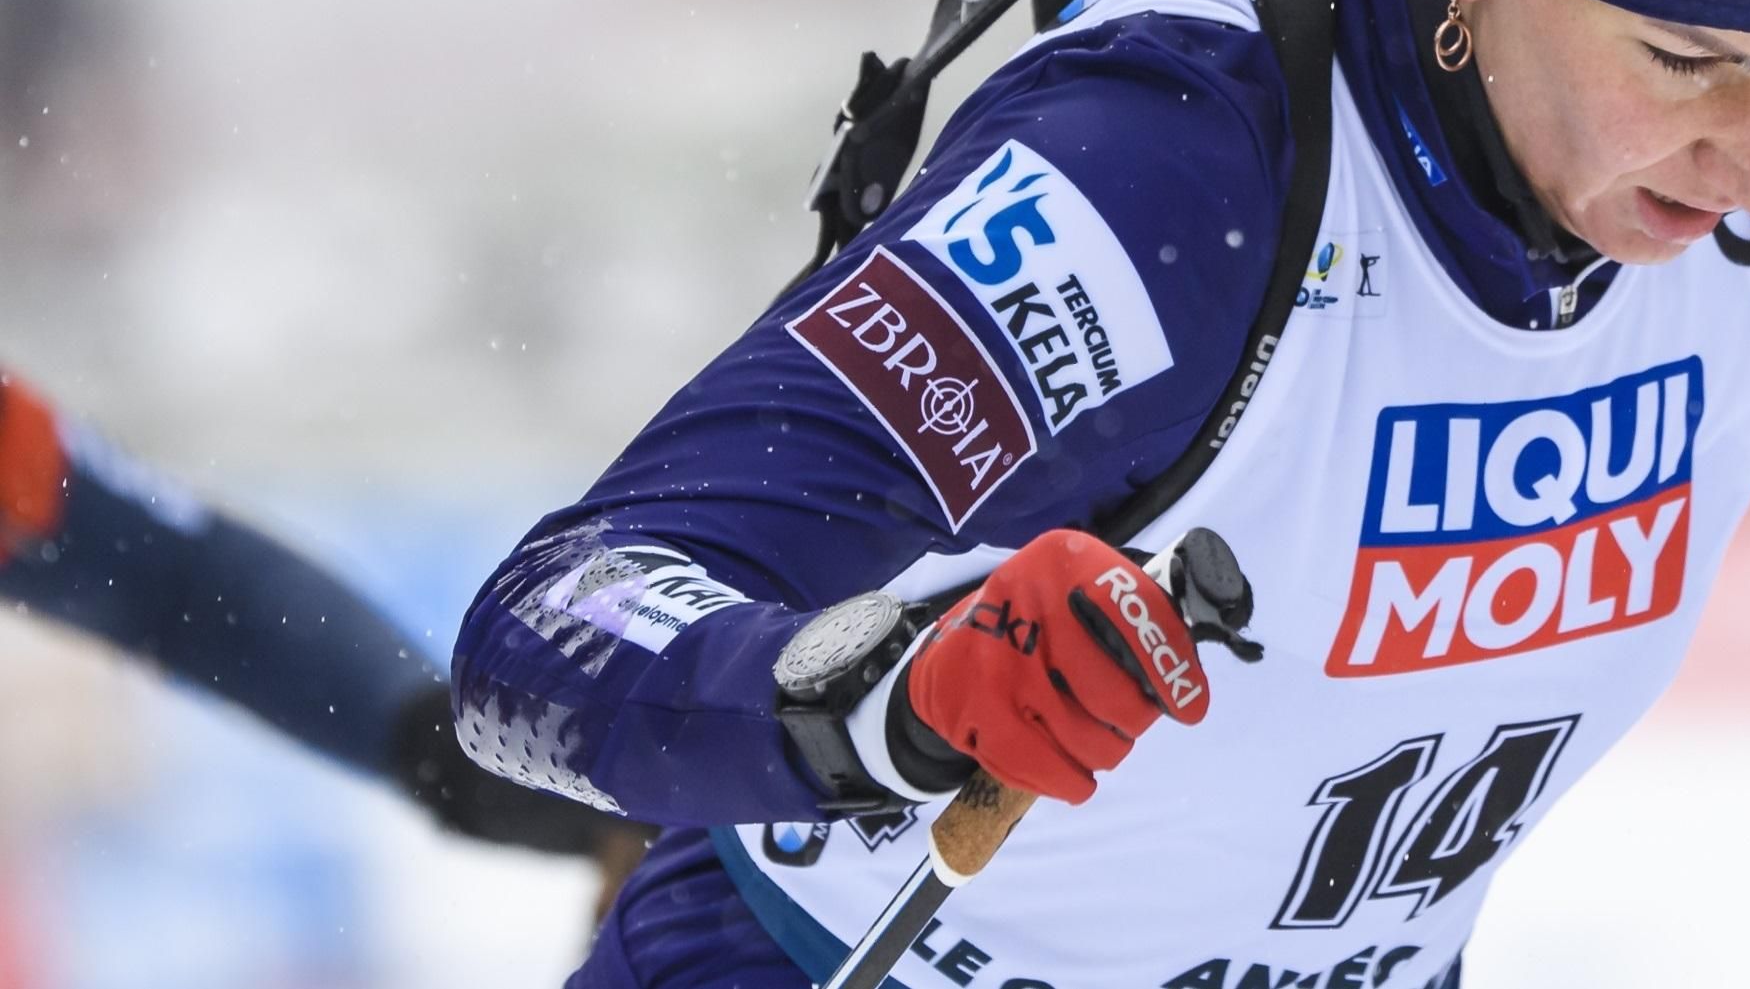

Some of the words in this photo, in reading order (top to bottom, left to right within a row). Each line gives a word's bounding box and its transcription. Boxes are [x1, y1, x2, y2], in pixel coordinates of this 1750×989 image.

[1056, 274, 1122, 397] TERCIUM
[1380, 372, 1688, 534] LIQUI
[1346, 497, 1686, 665] MOLY
[1270, 713, 1581, 929] 14
